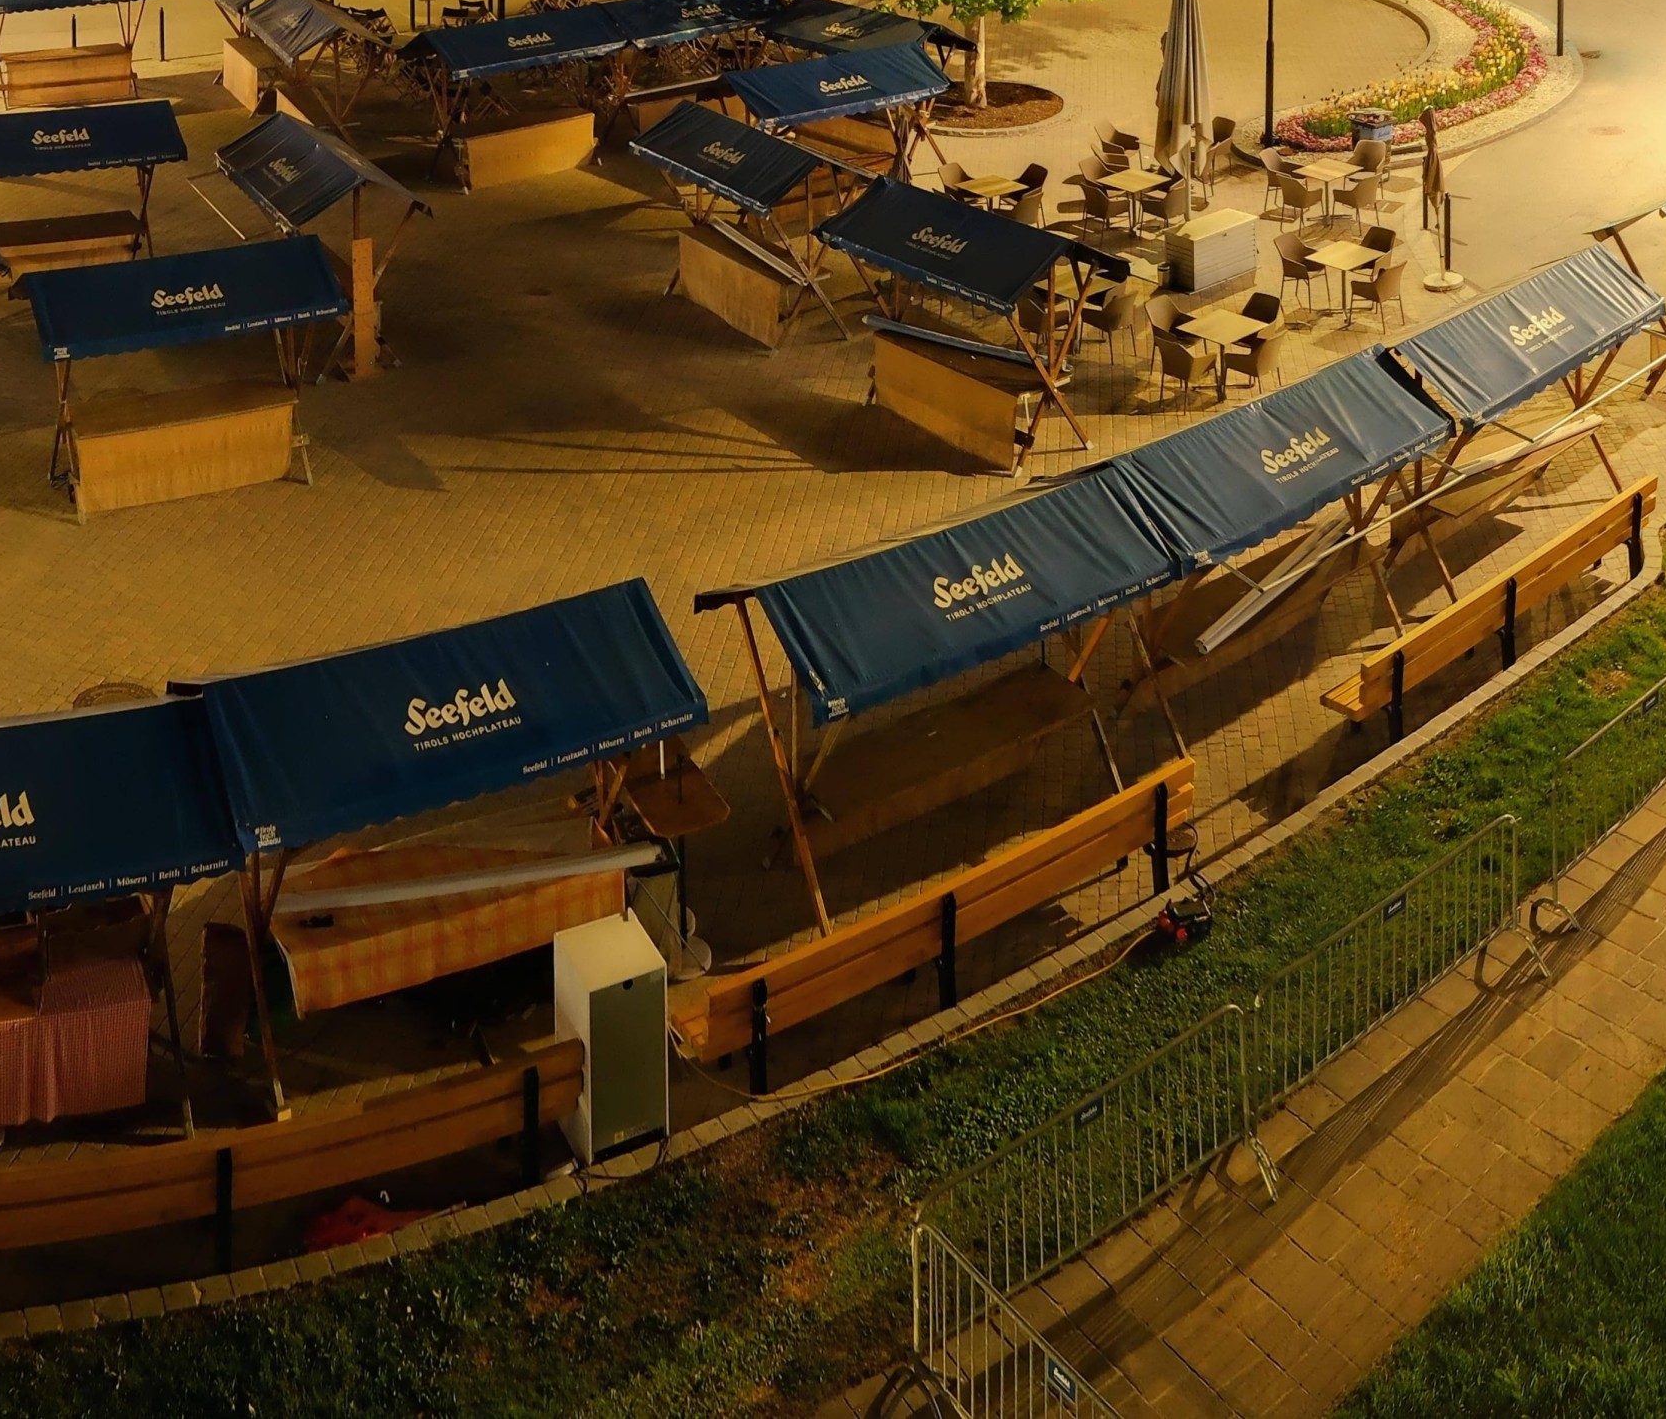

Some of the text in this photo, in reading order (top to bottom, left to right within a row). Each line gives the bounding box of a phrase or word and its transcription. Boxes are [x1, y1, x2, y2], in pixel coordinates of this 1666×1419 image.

[680, 4, 721, 19] Seefeld
[507, 31, 552, 48] Seefeld
[819, 74, 867, 93] Seefeld
[32, 127, 91, 146] Seefeld
[703, 141, 746, 165] Seefeld
[911, 225, 969, 254] Seefeld
[151, 283, 225, 310] Seefeld
[1513, 306, 1566, 347] Seefeld
[1261, 426, 1332, 474] Seefeld
[932, 551, 1025, 609] Seefeld
[945, 581, 1032, 622] TIROLS HOCHPLATEAU
[403, 678, 517, 736] Seefeld
[413, 715, 523, 752] TIROLS HOCHPLATEAU
[521, 711, 694, 775] Seefeld Leutasch Mösern Reith Scharnitz
[28, 858, 229, 900] Seefeld Leutasch Mösern Reith Scharnitz
